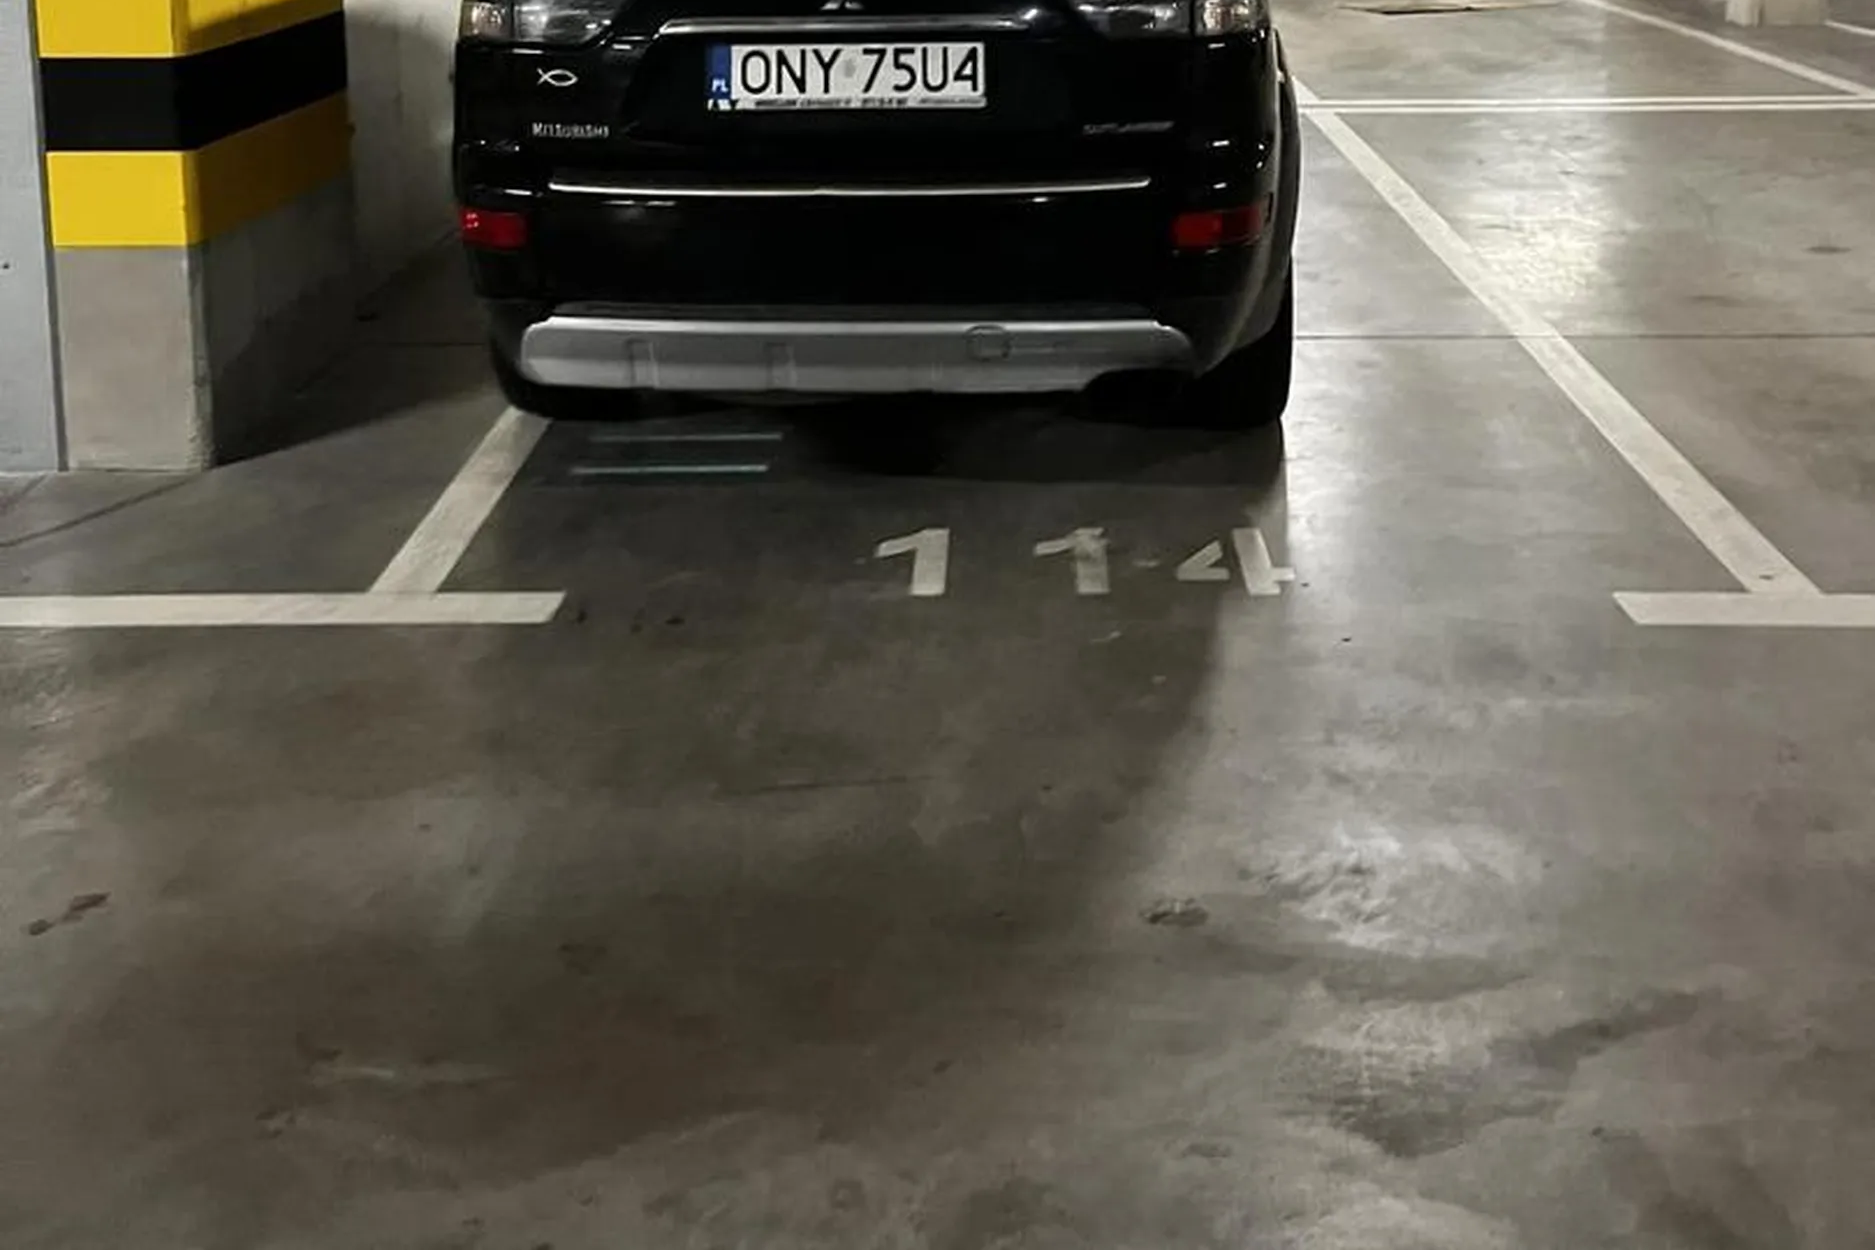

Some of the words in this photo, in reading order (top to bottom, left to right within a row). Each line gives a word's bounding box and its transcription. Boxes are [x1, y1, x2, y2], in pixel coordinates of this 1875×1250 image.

[740, 48, 842, 94] ONY
[862, 47, 979, 93] 75U4
[873, 527, 1296, 596] 114
